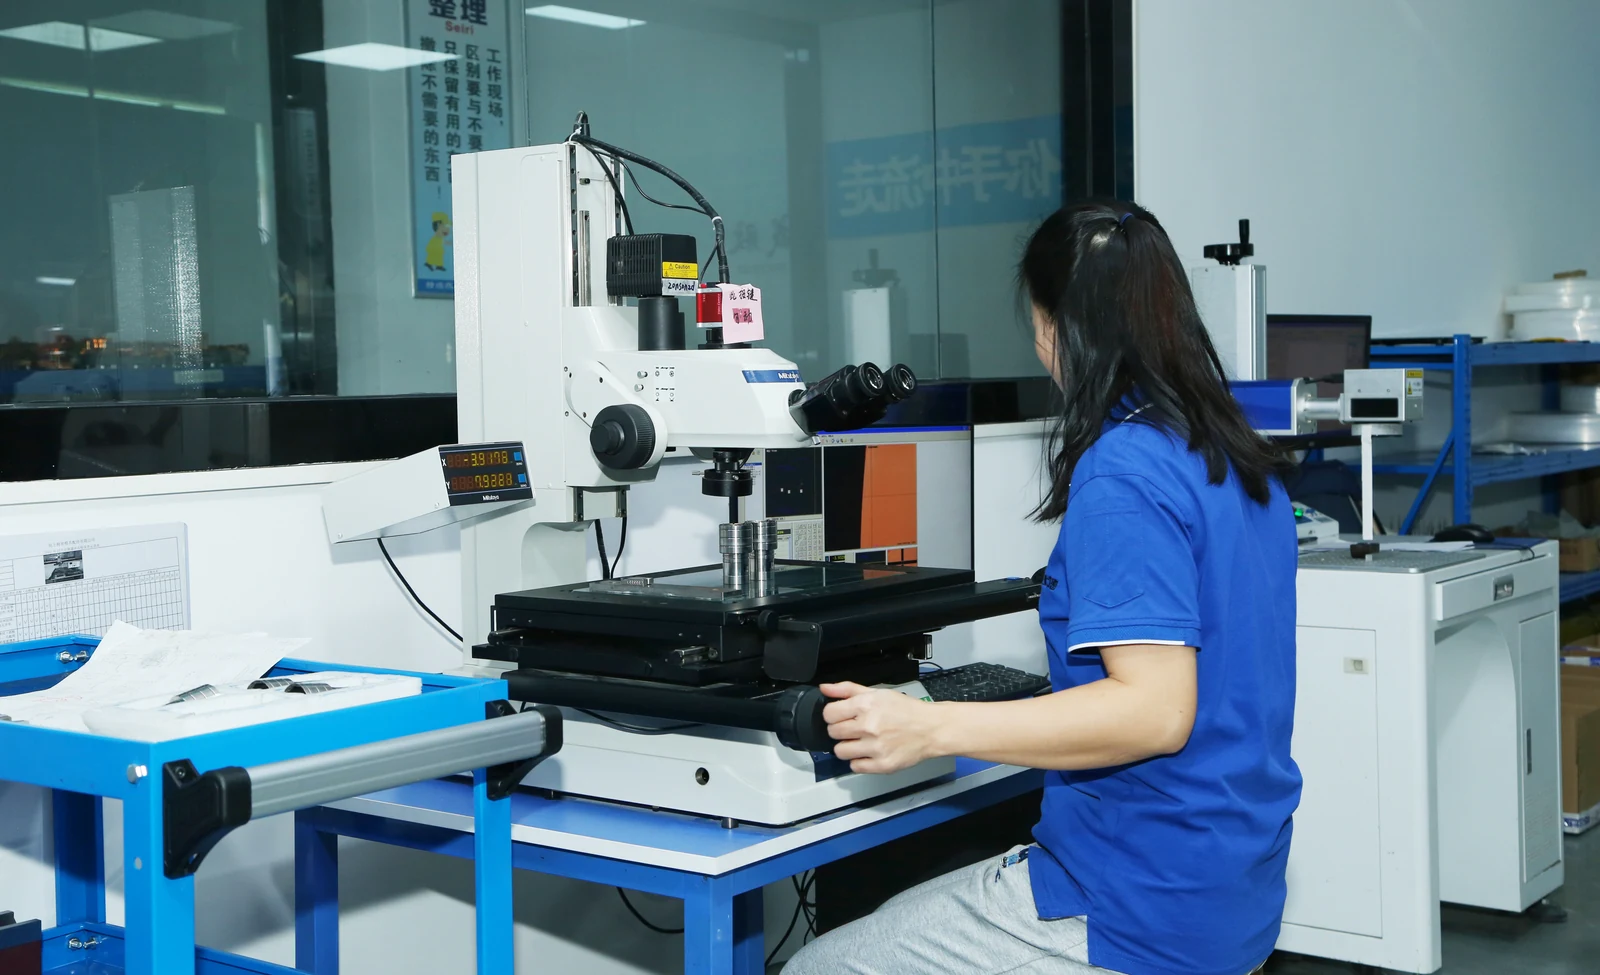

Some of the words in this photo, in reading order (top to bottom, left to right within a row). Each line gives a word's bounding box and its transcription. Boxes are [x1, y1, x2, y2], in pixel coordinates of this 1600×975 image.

[428, 0, 488, 26] 整理
[445, 21, 474, 35] Seiri
[441, 458, 447, 467] X
[445, 481, 451, 490] Y
